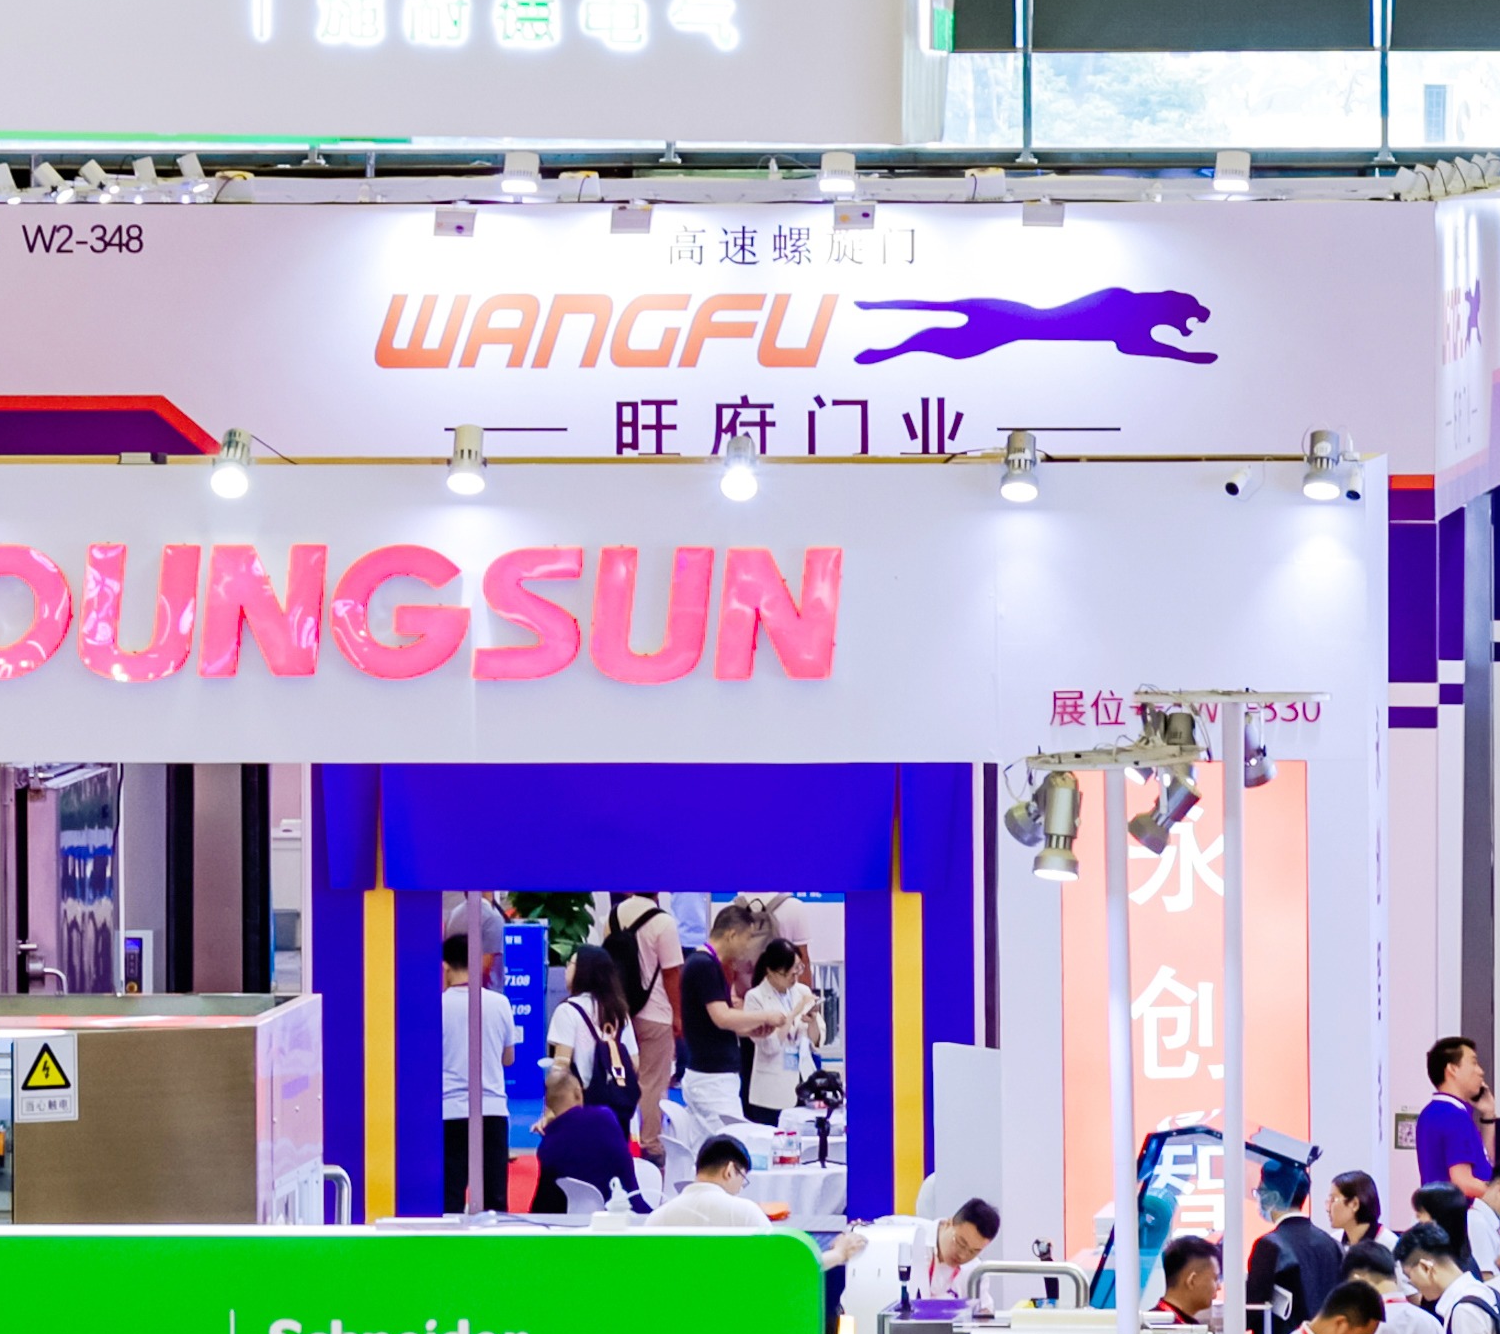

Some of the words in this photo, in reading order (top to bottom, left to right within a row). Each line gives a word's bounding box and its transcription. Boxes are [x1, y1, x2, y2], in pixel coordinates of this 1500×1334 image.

[21, 223, 145, 257] W2-348
[666, 224, 920, 267] 高速螺旋门
[372, 293, 841, 370] WANGFU
[614, 397, 967, 457] 旺府门业
